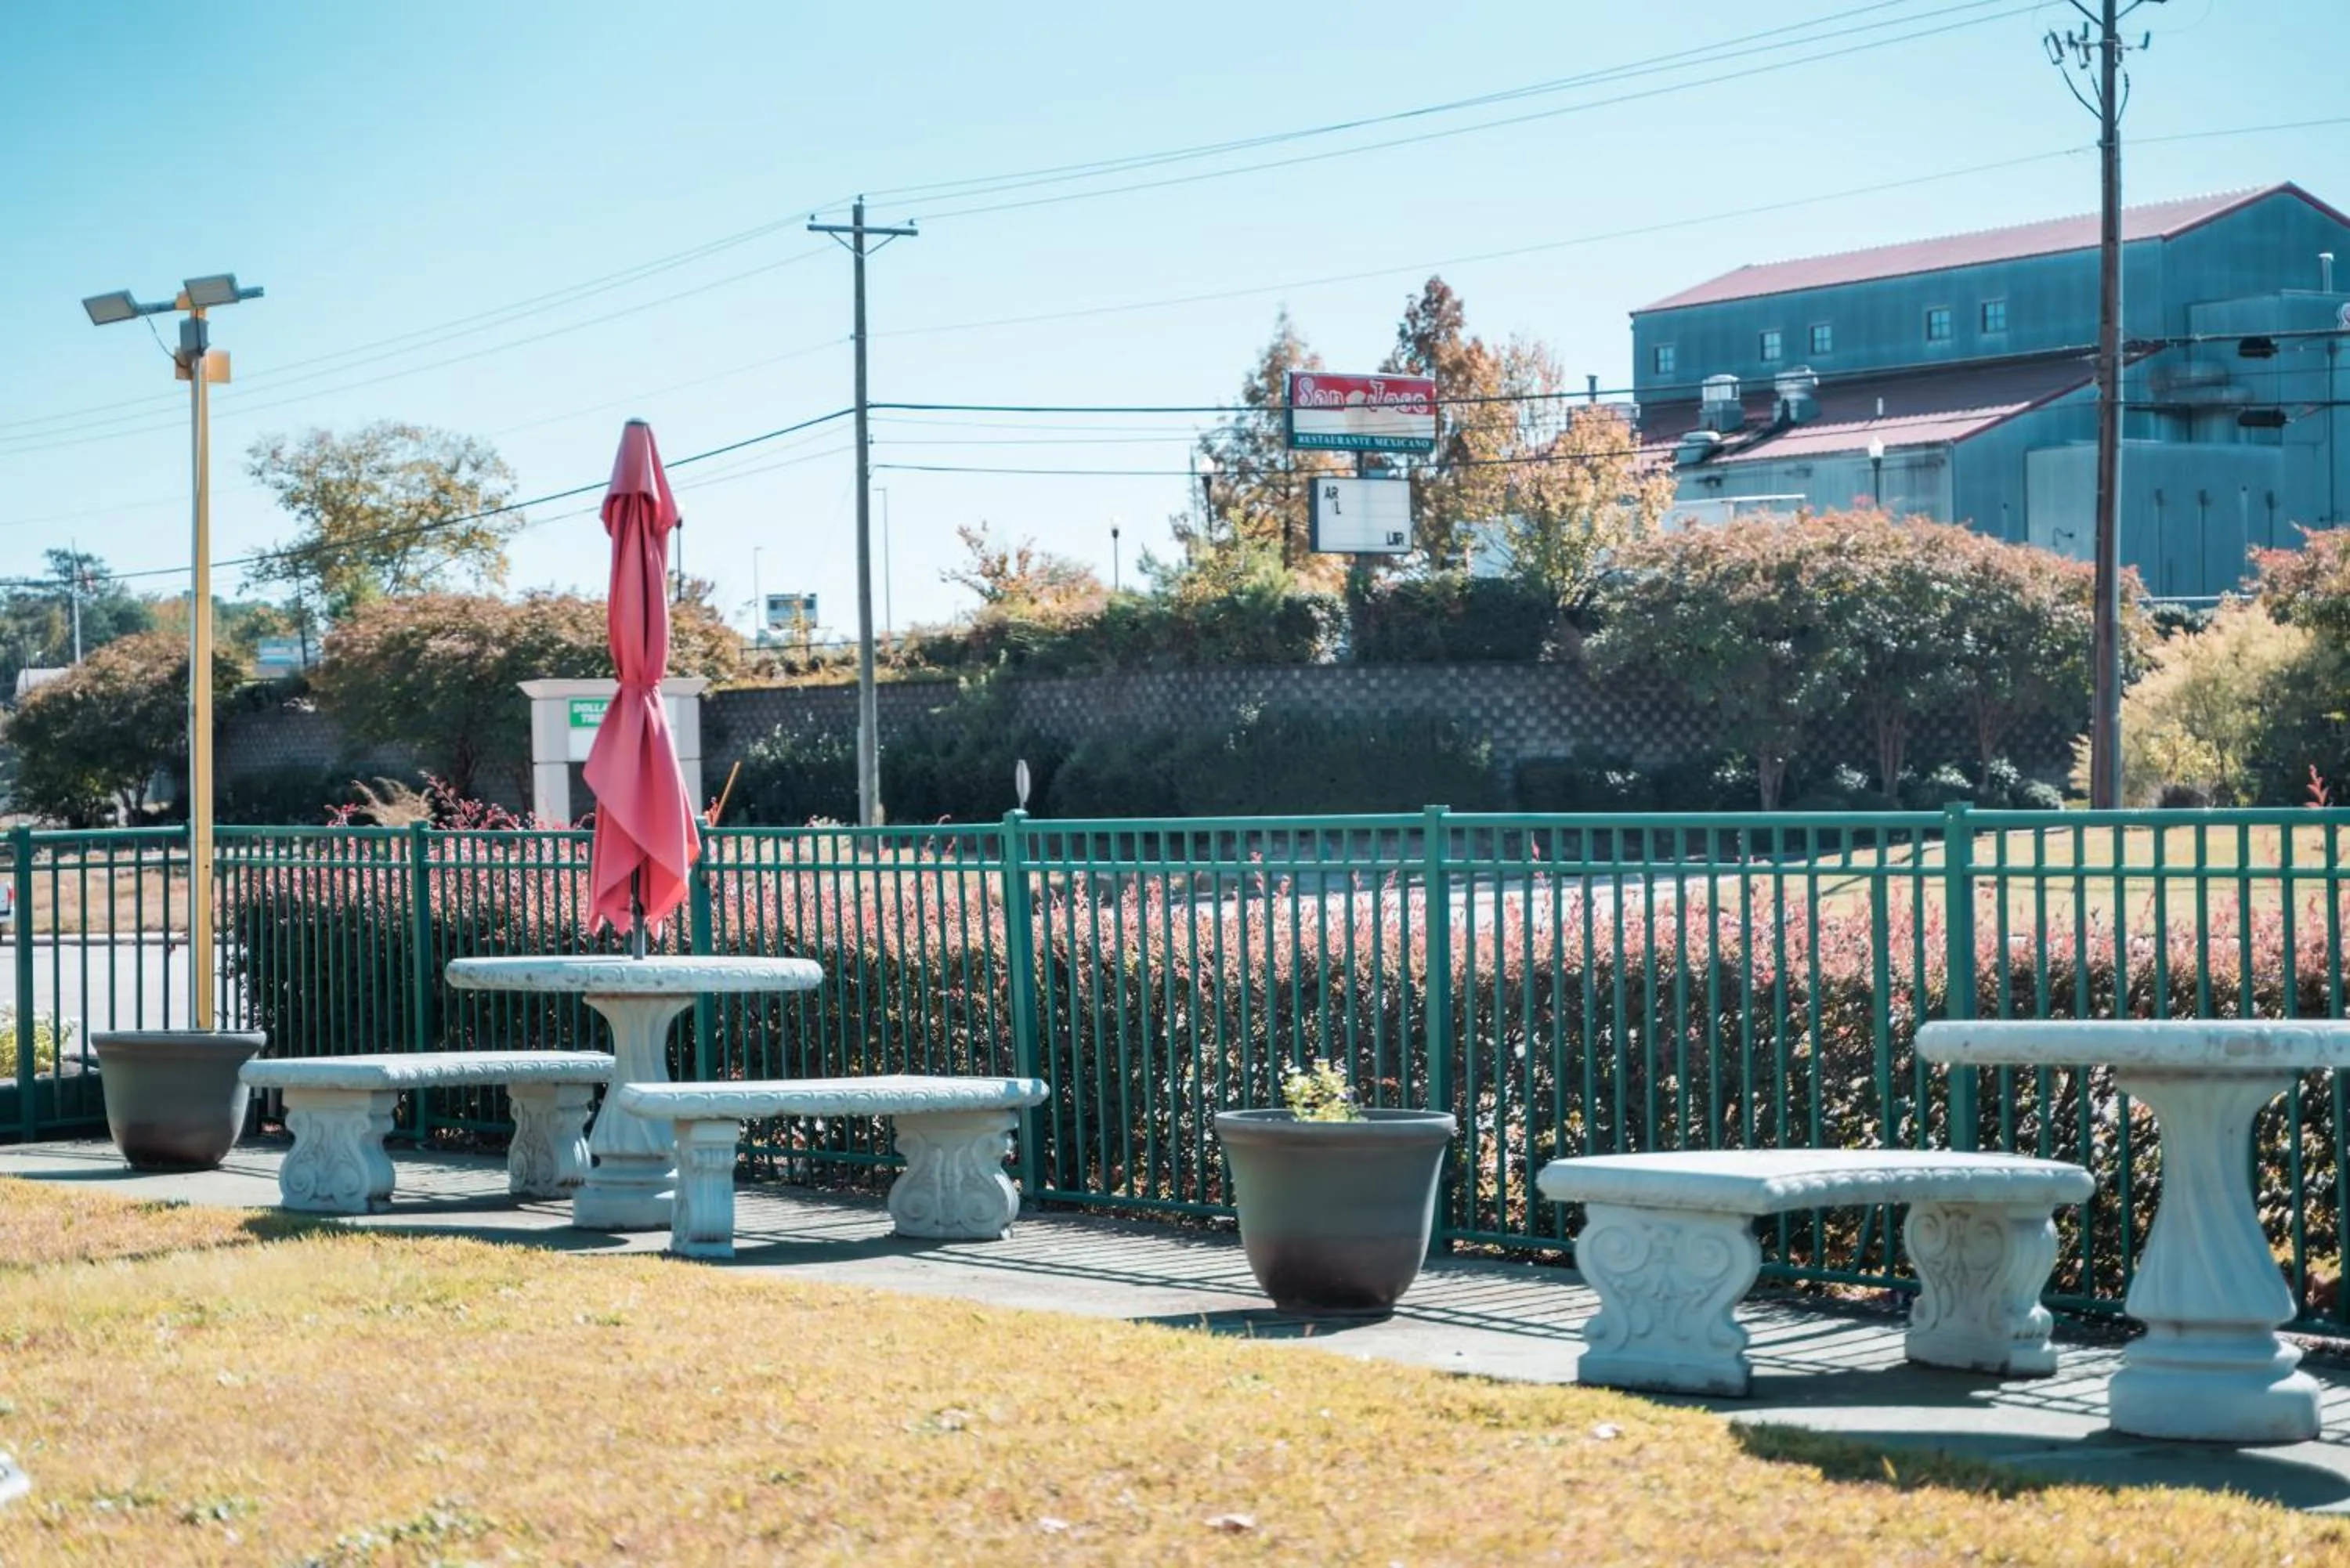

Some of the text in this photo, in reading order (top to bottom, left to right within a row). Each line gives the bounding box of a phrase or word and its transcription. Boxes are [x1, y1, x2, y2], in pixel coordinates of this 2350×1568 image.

[1298, 377, 1428, 414] San Jose
[1297, 435, 1430, 449] RESTAURANTE MEXICANO
[573, 703, 608, 713] DOLLA
